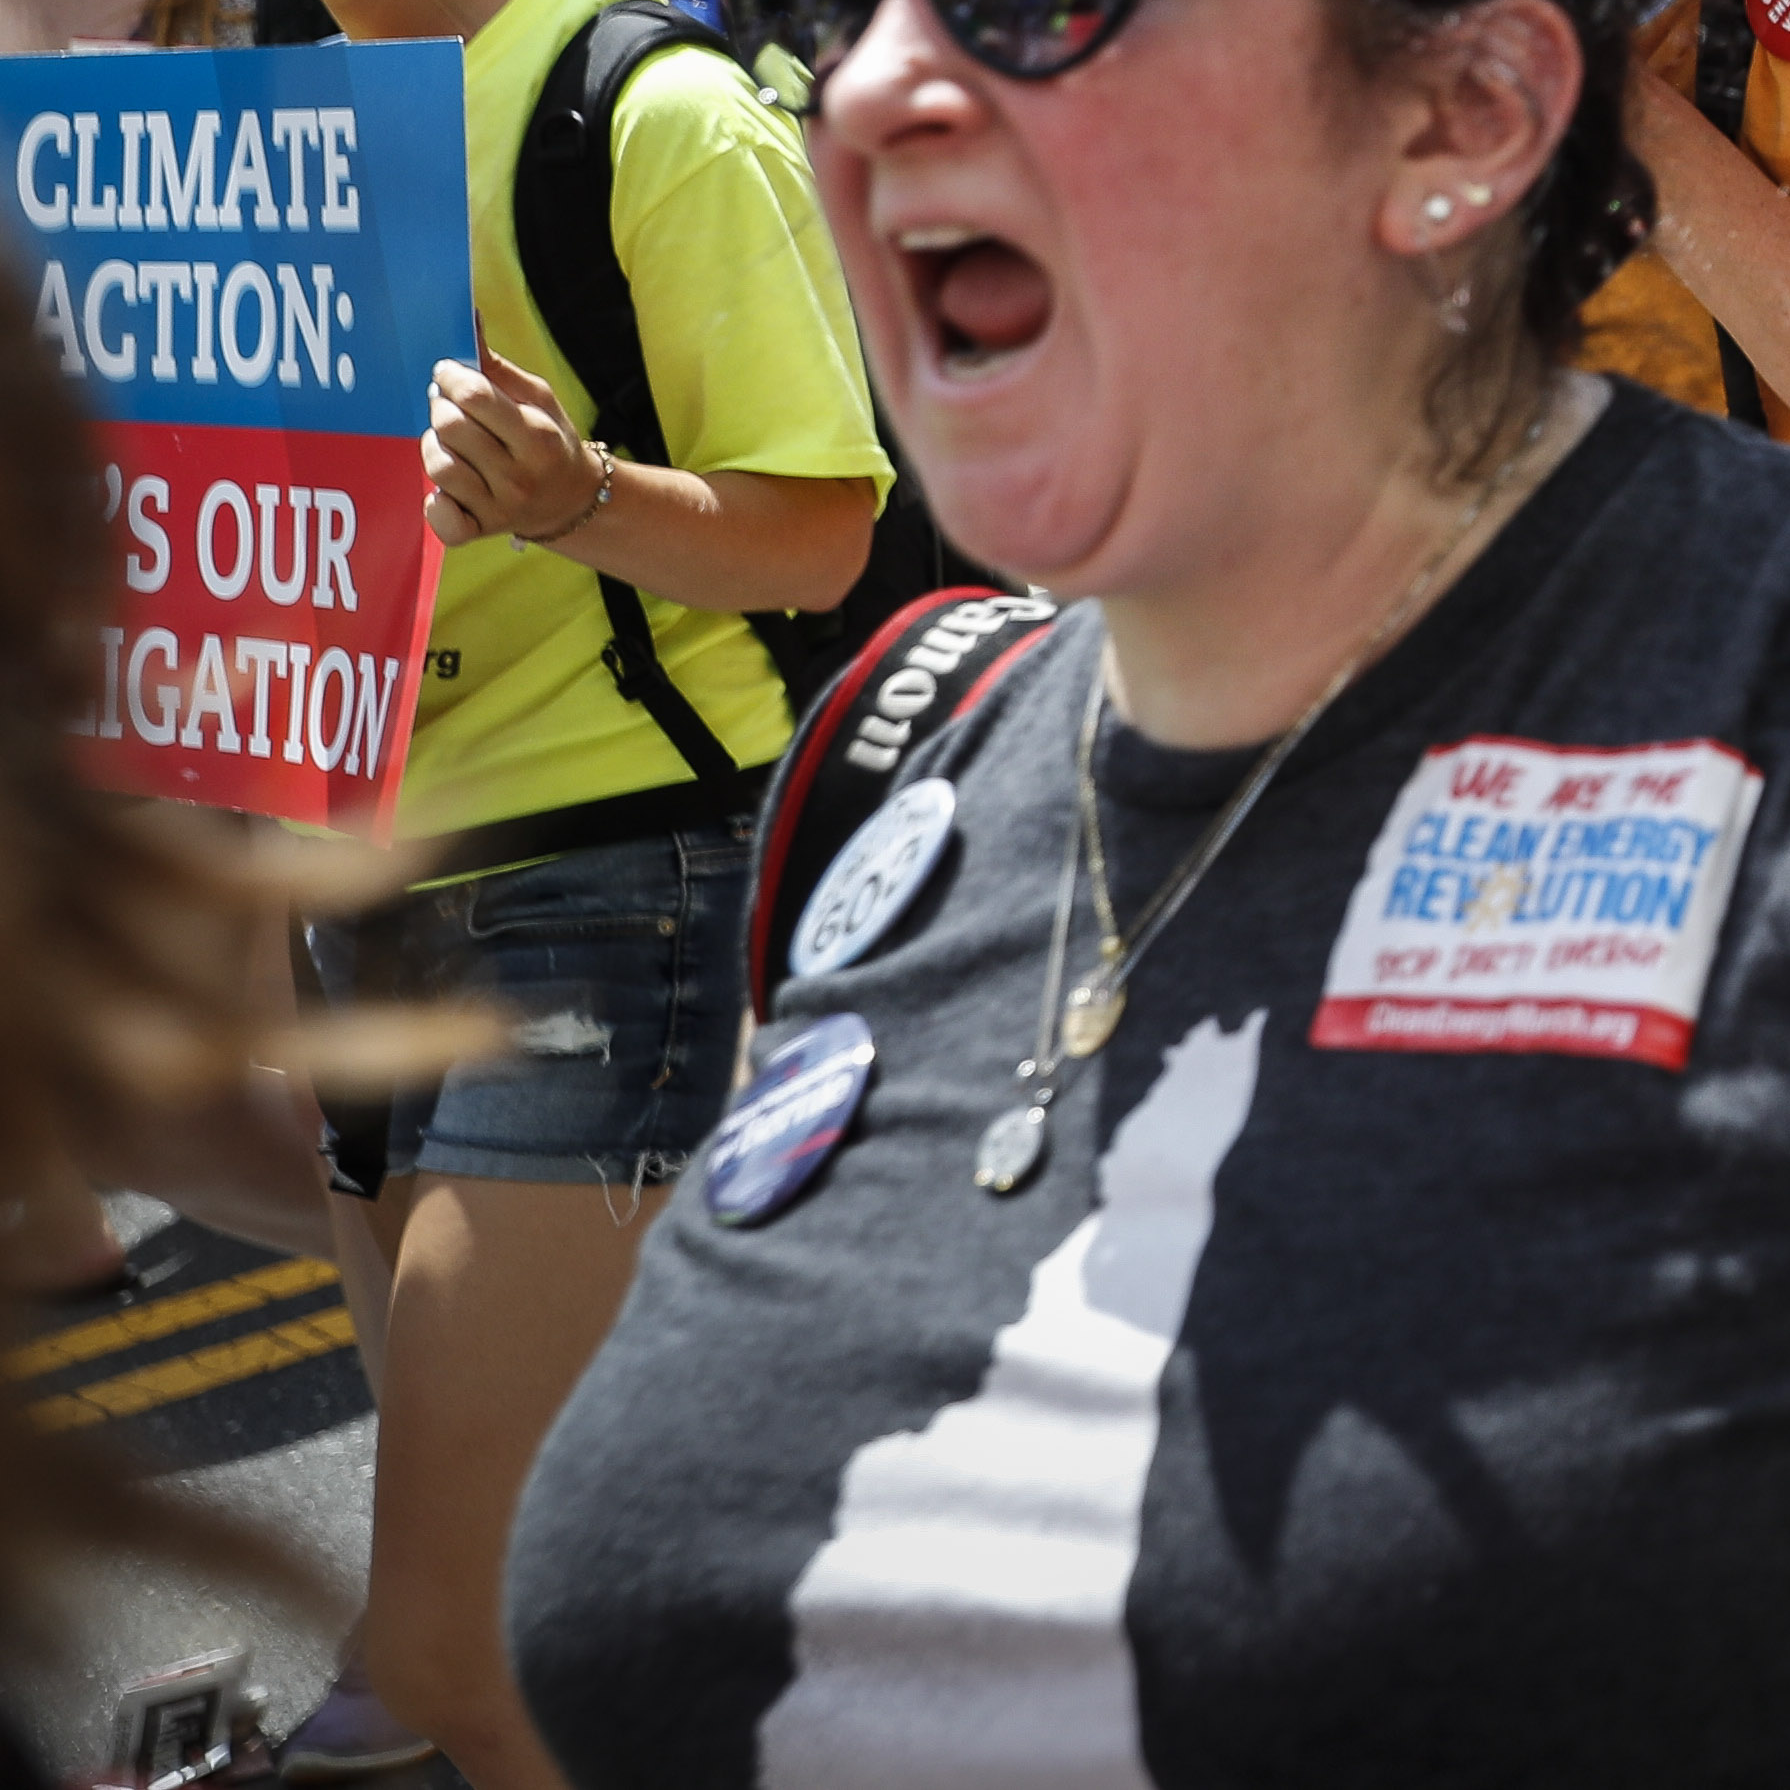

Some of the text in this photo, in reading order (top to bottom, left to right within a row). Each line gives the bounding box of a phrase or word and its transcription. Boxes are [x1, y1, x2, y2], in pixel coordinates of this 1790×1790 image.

[15, 105, 361, 234] CLIMATE
[34, 259, 356, 394] ACTION:
[195, 478, 359, 611] OUR
[1447, 759, 1527, 810] WE
[1401, 812, 1720, 868] CLEAN ENERGY
[1382, 862, 1695, 934] REVOLUTION
